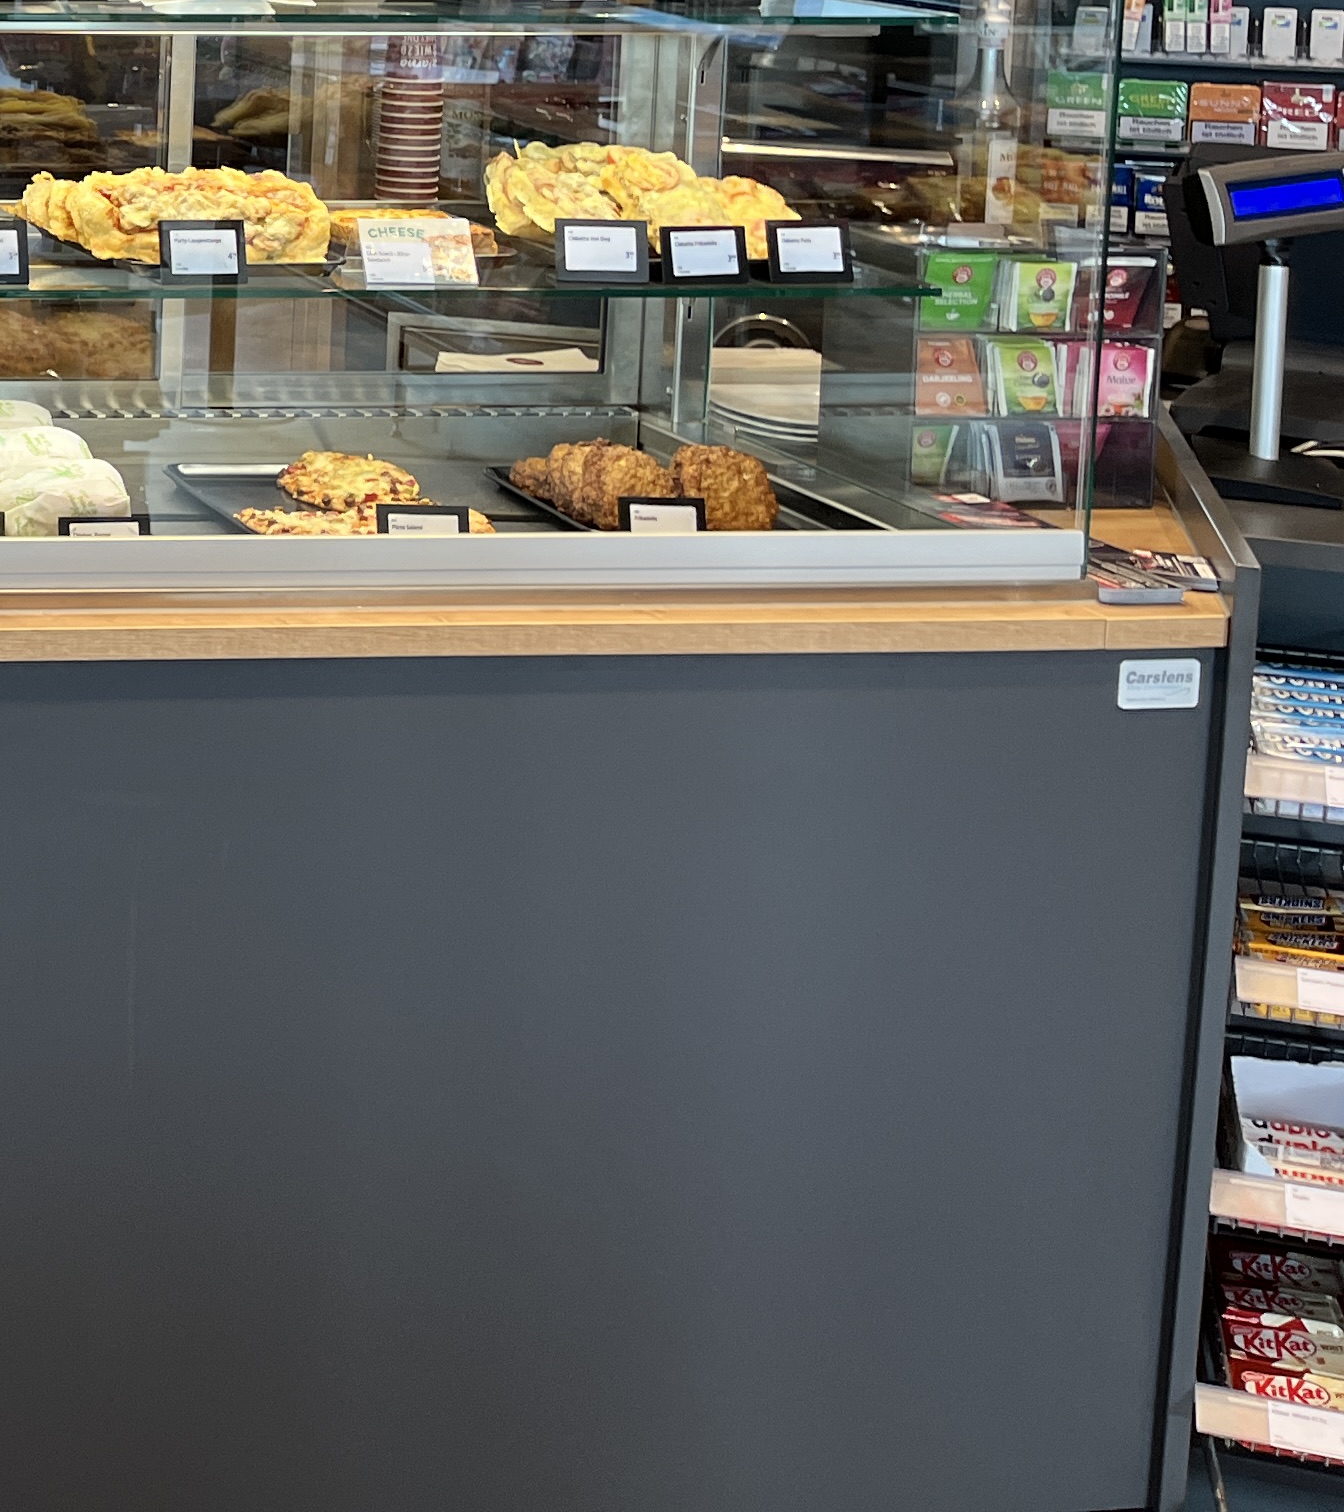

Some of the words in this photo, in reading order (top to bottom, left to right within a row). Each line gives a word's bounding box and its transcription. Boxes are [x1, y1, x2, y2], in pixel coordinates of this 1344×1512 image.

[367, 226, 425, 239] CHEESE
[922, 375, 973, 383] DARJEELING
[1106, 375, 1136, 385] Malve
[1125, 670, 1194, 685] Carstens
[1241, 1254, 1307, 1286] KitKat
[1233, 1289, 1303, 1317] KitKat
[1242, 1331, 1311, 1365] KitKat
[1253, 1376, 1326, 1405] KitKat
